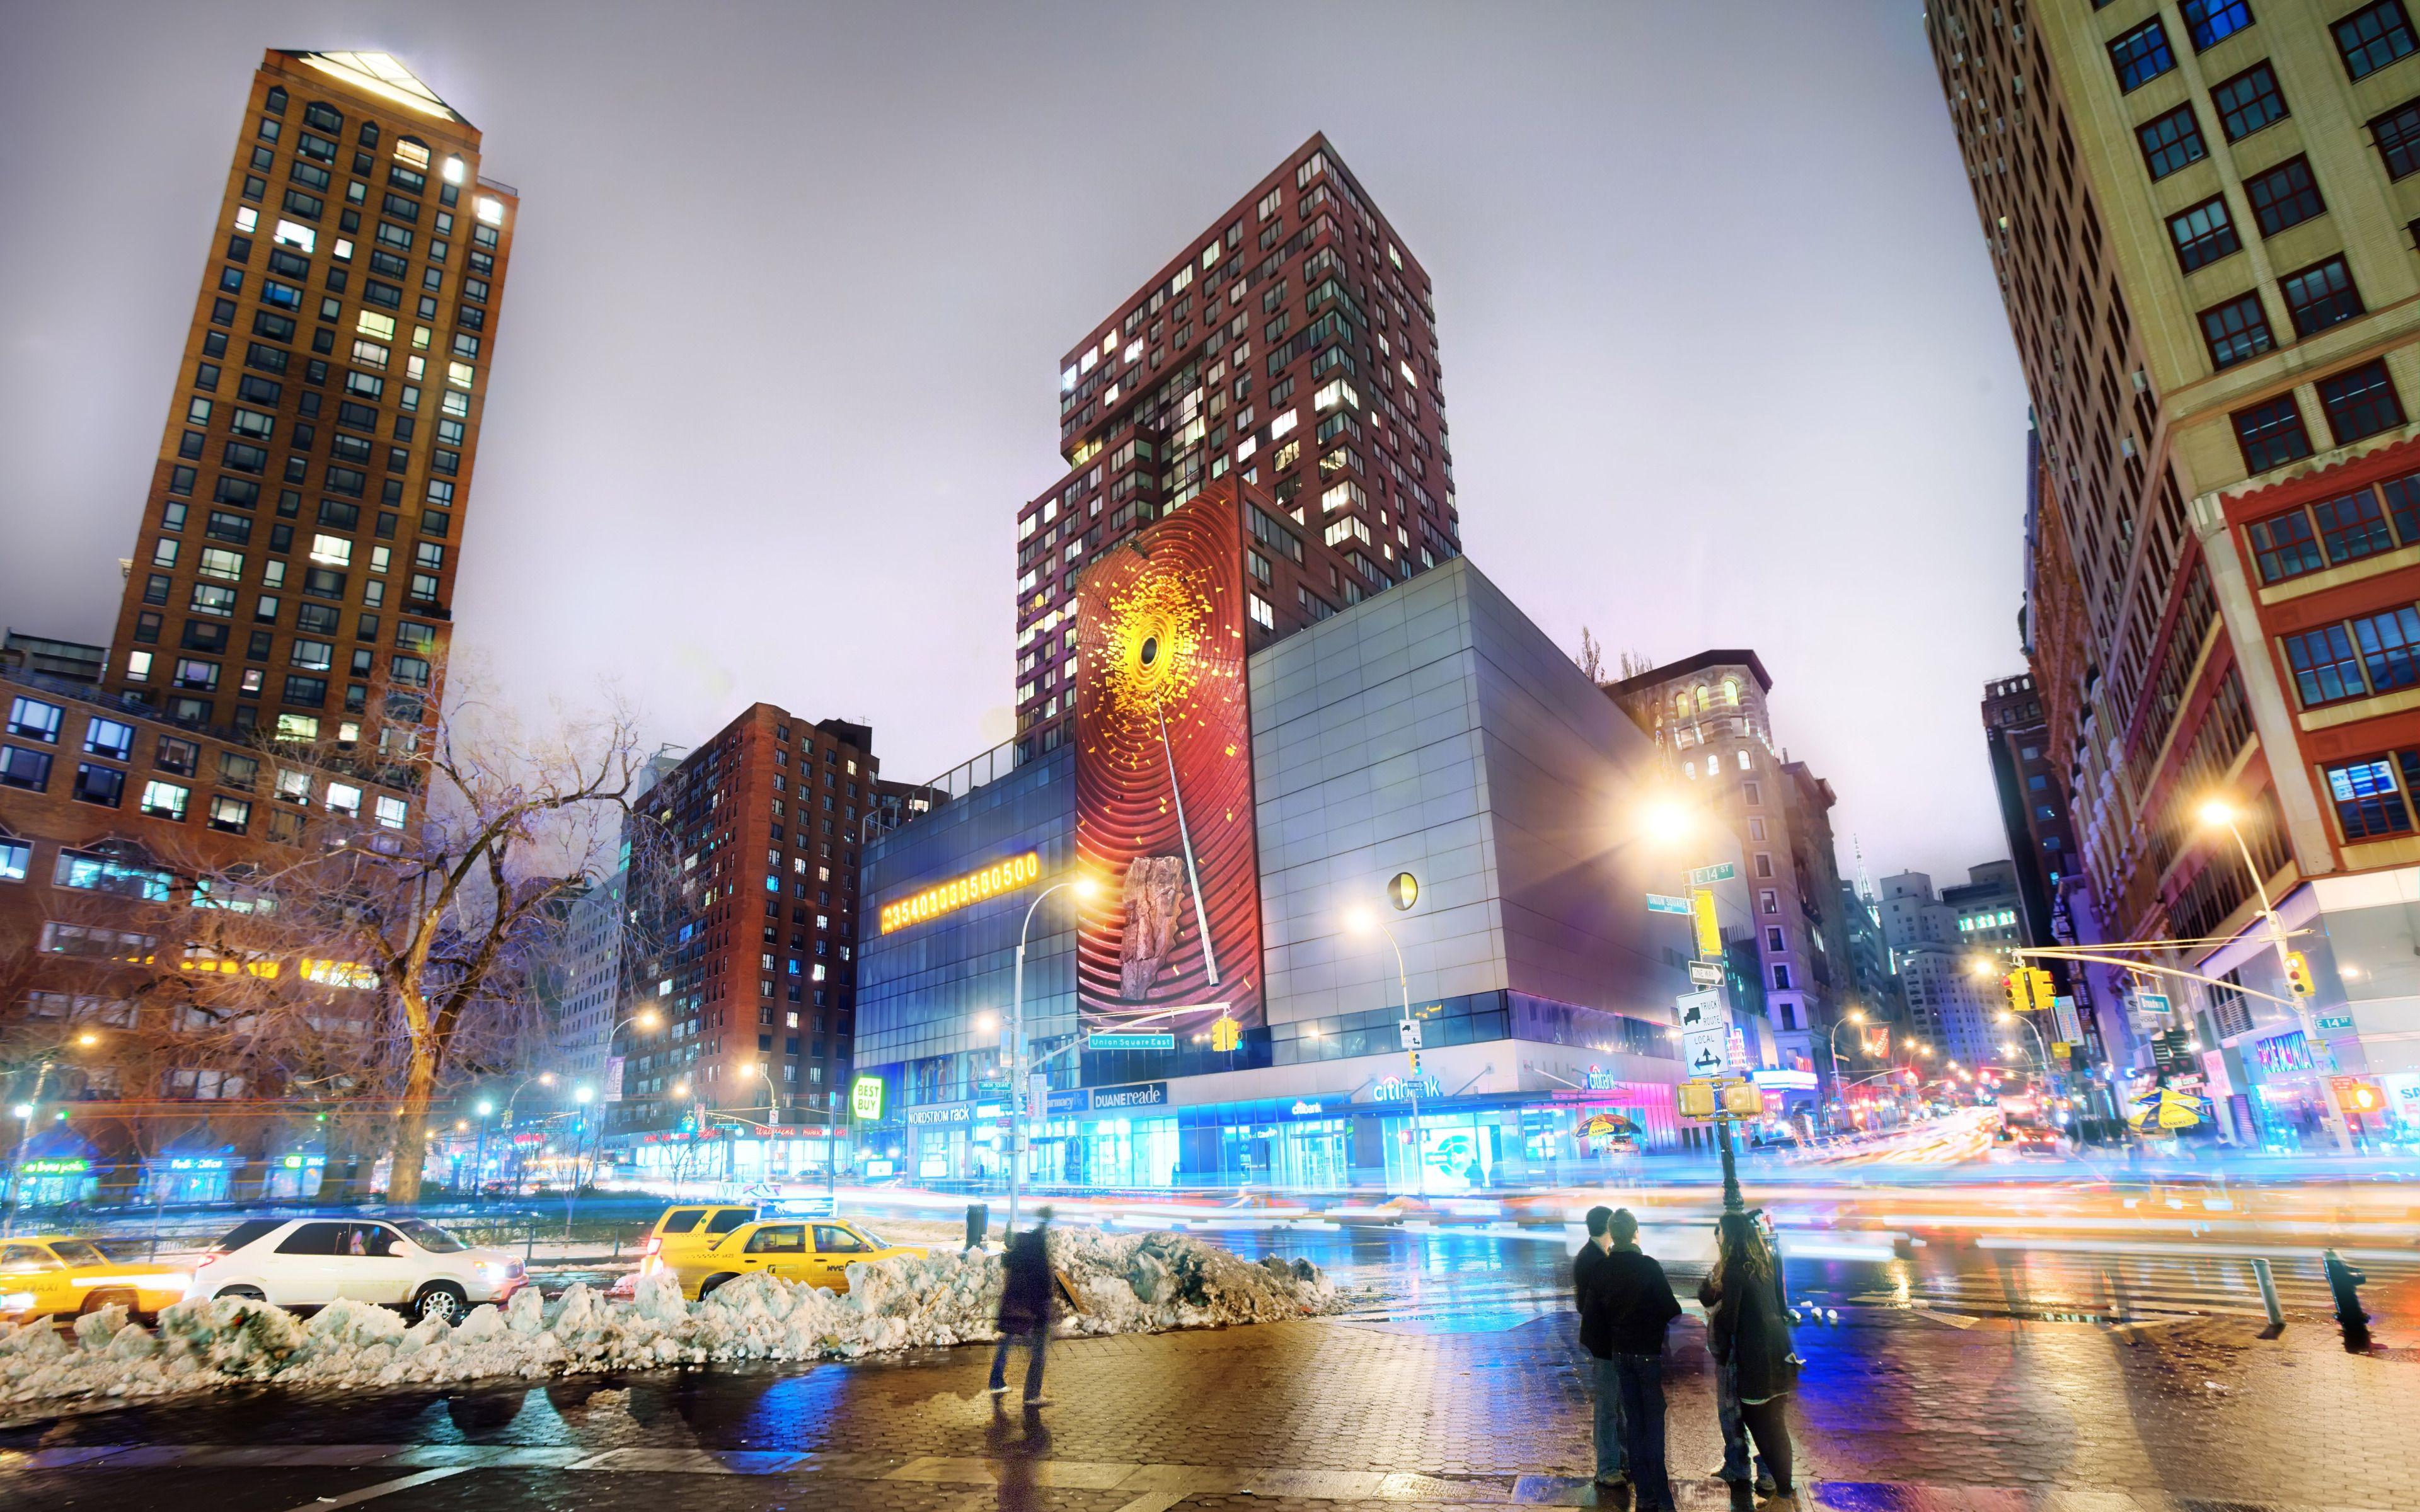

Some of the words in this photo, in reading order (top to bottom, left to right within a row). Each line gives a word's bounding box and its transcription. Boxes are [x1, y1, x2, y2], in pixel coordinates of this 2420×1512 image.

[1696, 871, 1703, 883] E
[1707, 868, 1717, 881] 14
[1649, 895, 1664, 905] UNION
[1700, 1001, 1717, 1009] TRUCK
[1703, 1015, 1720, 1026] ROUTE
[2317, 1020, 2324, 1028] E
[2326, 1018, 2339, 1027] 14
[1119, 1038, 1149, 1048] Square
[1151, 1038, 1170, 1046] East
[1695, 1035, 1715, 1045] LOCAL
[1589, 1069, 1615, 1089] citibank
[858, 1085, 879, 1097] BEST
[858, 1099, 875, 1111] BUY
[1047, 1097, 1073, 1110] armacy
[908, 1110, 948, 1125] NORDSTROM
[950, 1103, 970, 1121] rack
[756, 1126, 795, 1136] Walreens
